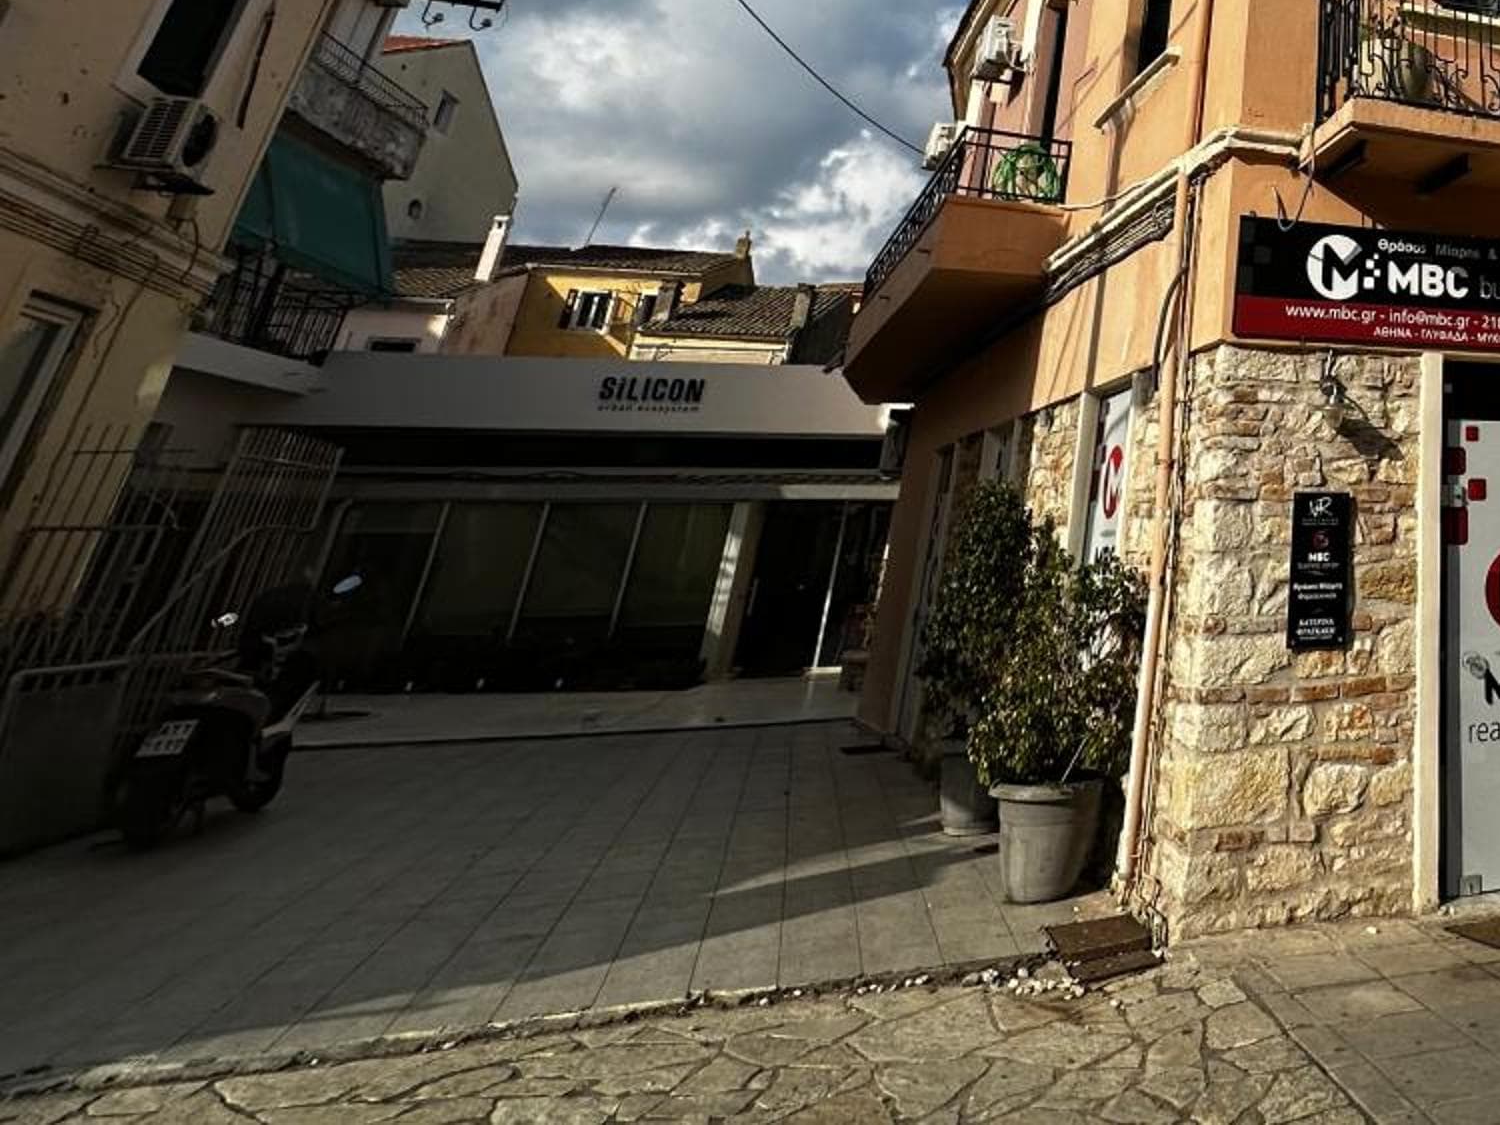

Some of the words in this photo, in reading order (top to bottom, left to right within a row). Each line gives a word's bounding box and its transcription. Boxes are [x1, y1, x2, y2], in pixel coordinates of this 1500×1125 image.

[1387, 260, 1469, 299] MBC
[1285, 306, 1377, 325] www.mbc.gr
[1389, 309, 1471, 330] info@mbc.gr
